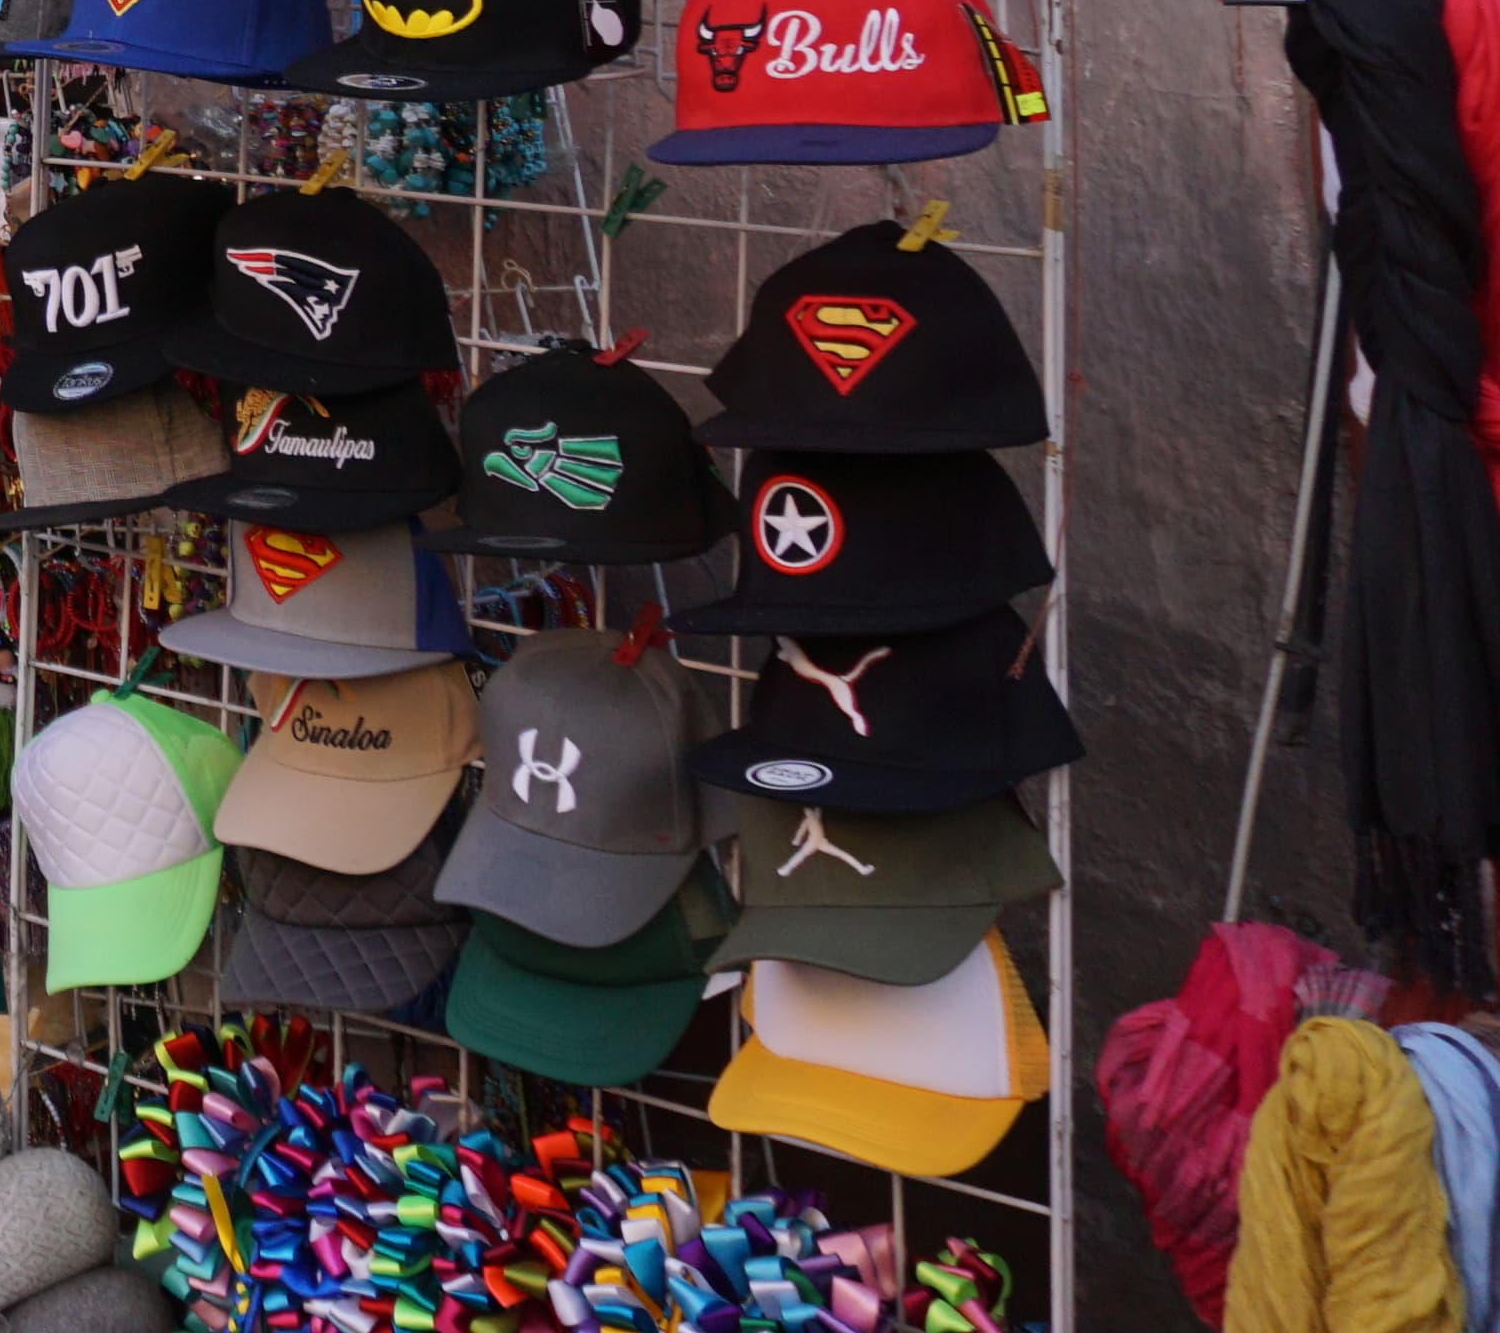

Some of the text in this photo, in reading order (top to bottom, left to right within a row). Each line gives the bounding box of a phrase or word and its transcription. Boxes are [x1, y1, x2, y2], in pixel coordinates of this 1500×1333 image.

[766, 8, 926, 79] Bulls
[23, 254, 131, 333] 701
[265, 419, 376, 470] Tamaulipas
[291, 704, 393, 751] Sinaloa
